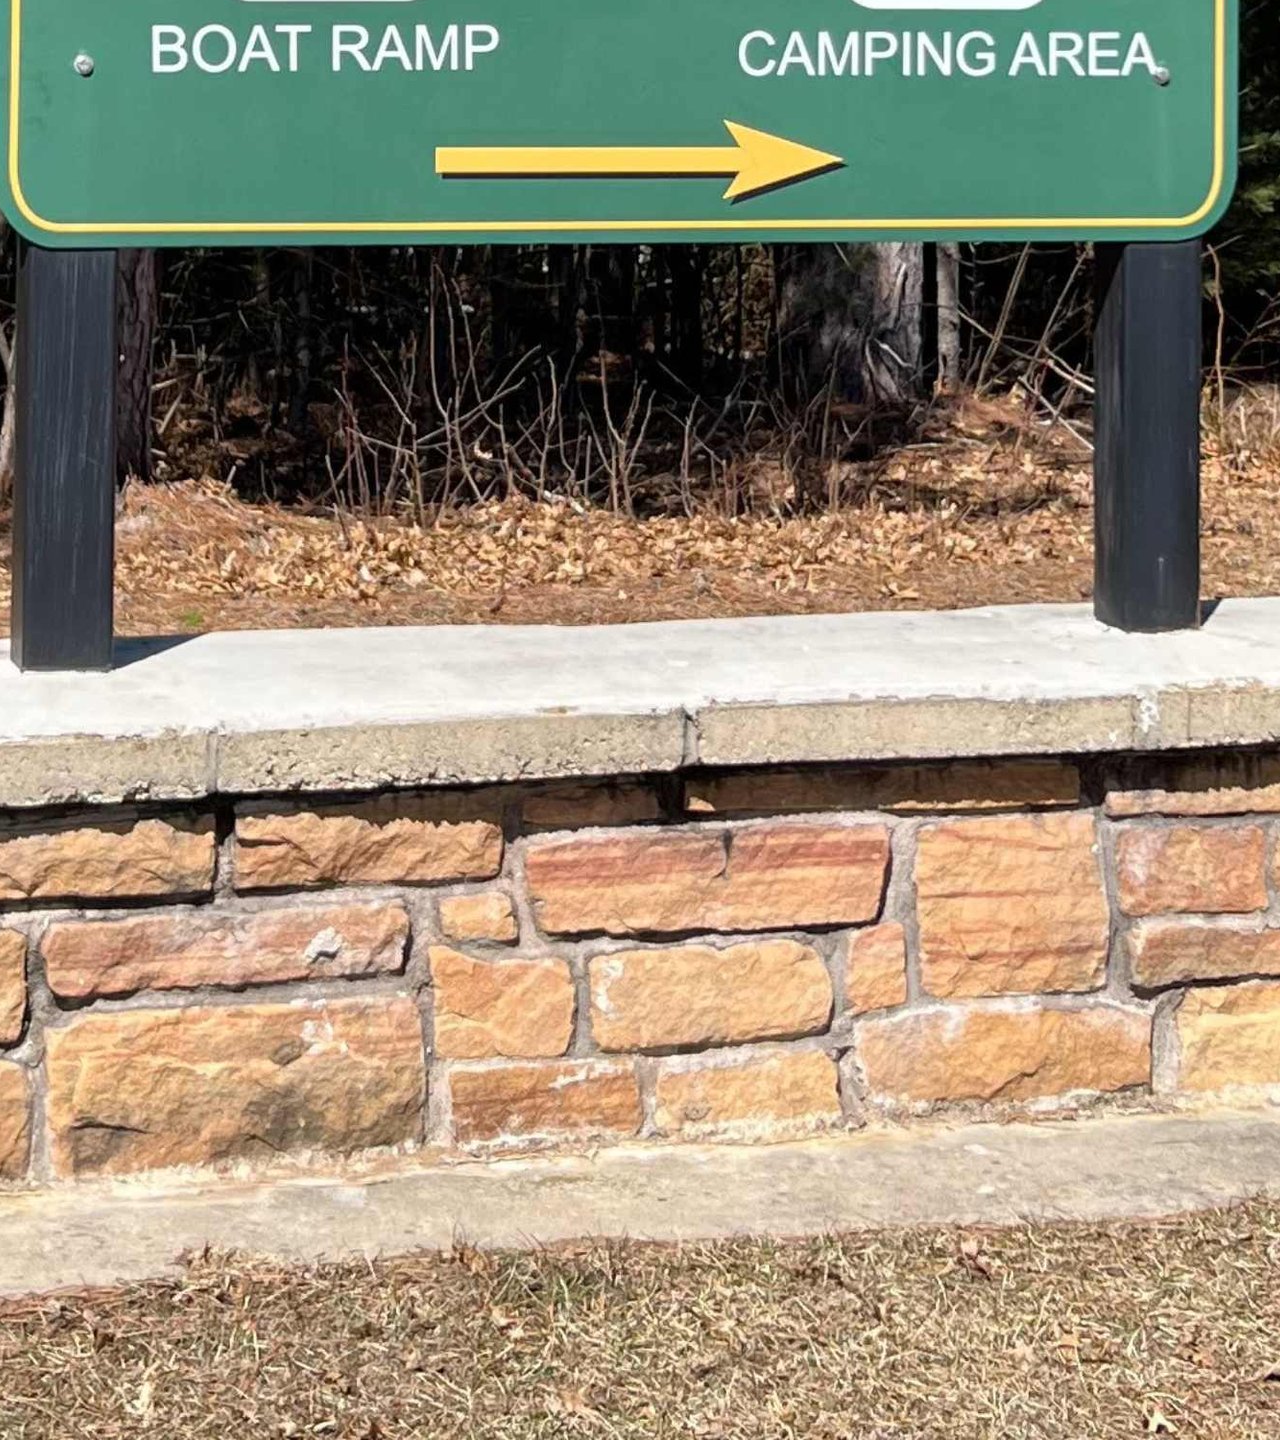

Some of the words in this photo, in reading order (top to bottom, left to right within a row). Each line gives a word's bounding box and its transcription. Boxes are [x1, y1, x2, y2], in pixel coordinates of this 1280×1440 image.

[151, 24, 312, 73] BOAT
[332, 24, 500, 71] RAMP
[738, 30, 997, 77] CAMPING
[1008, 31, 1159, 77] AREA
